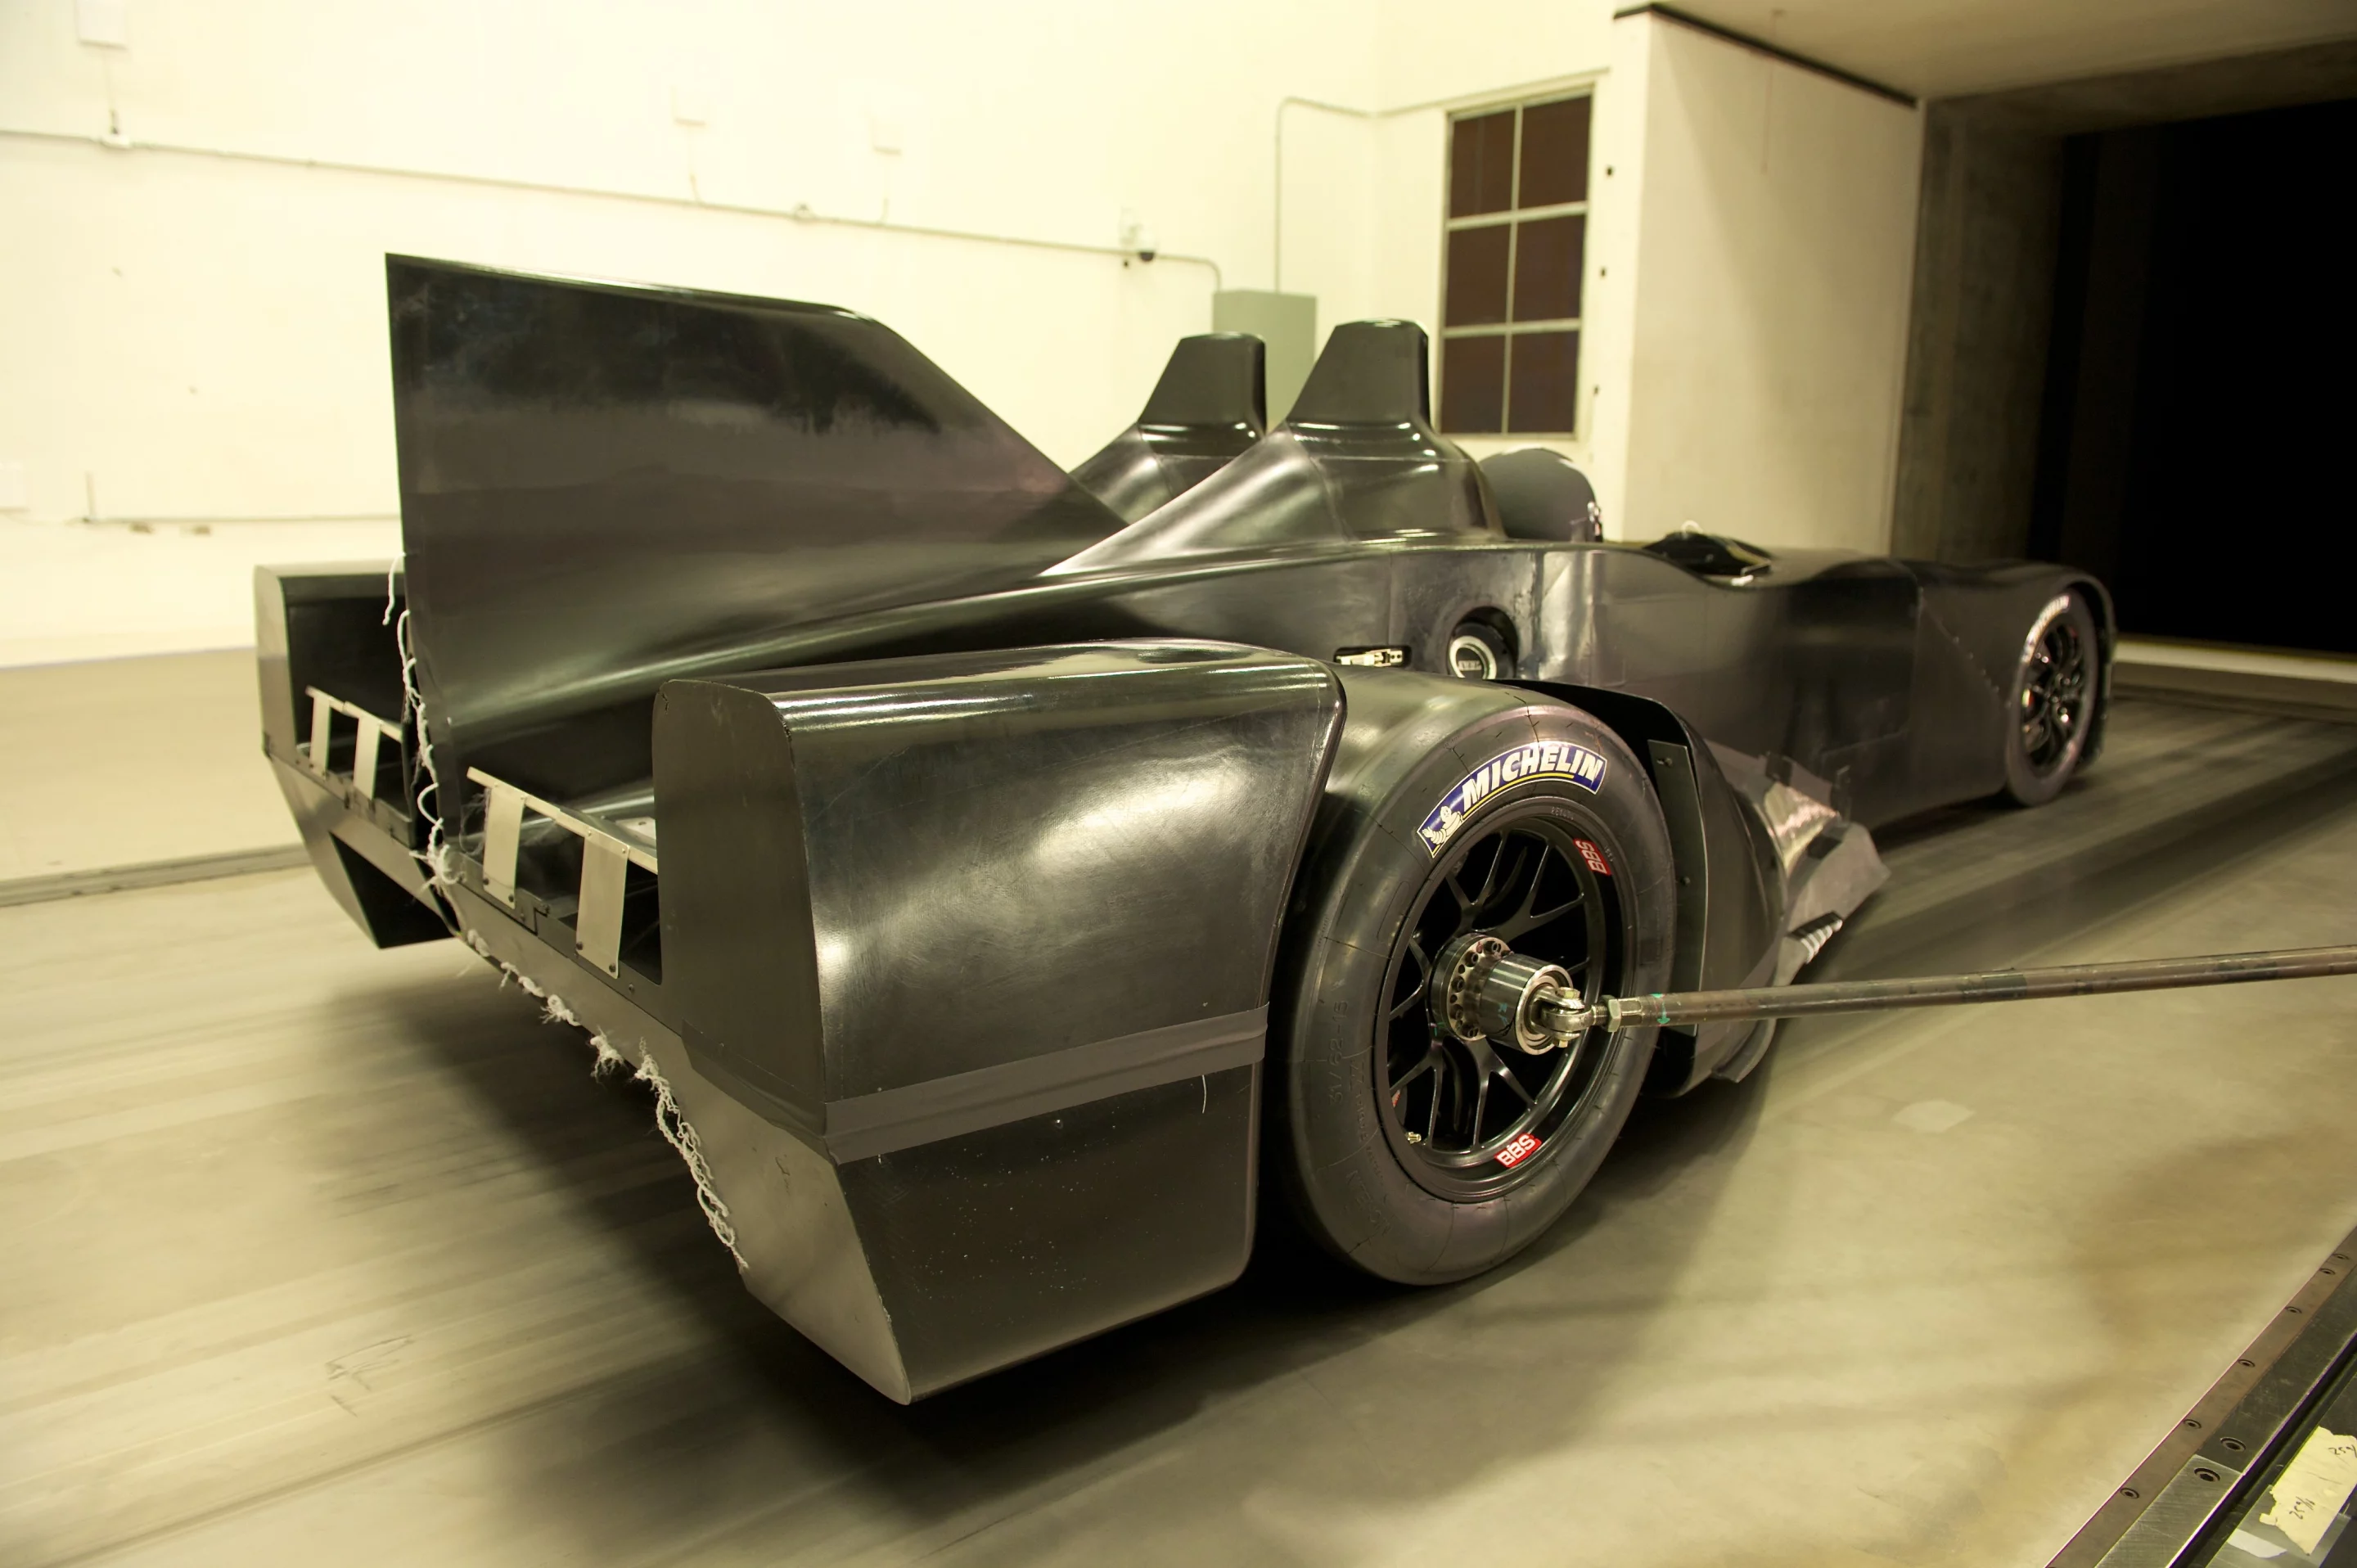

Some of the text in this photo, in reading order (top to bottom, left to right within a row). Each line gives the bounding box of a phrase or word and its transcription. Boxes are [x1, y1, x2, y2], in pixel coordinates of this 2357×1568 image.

[1462, 746, 1605, 812] MICHELIN
[1575, 840, 1608, 875] BBS
[1496, 1134, 1536, 1166] BBS
